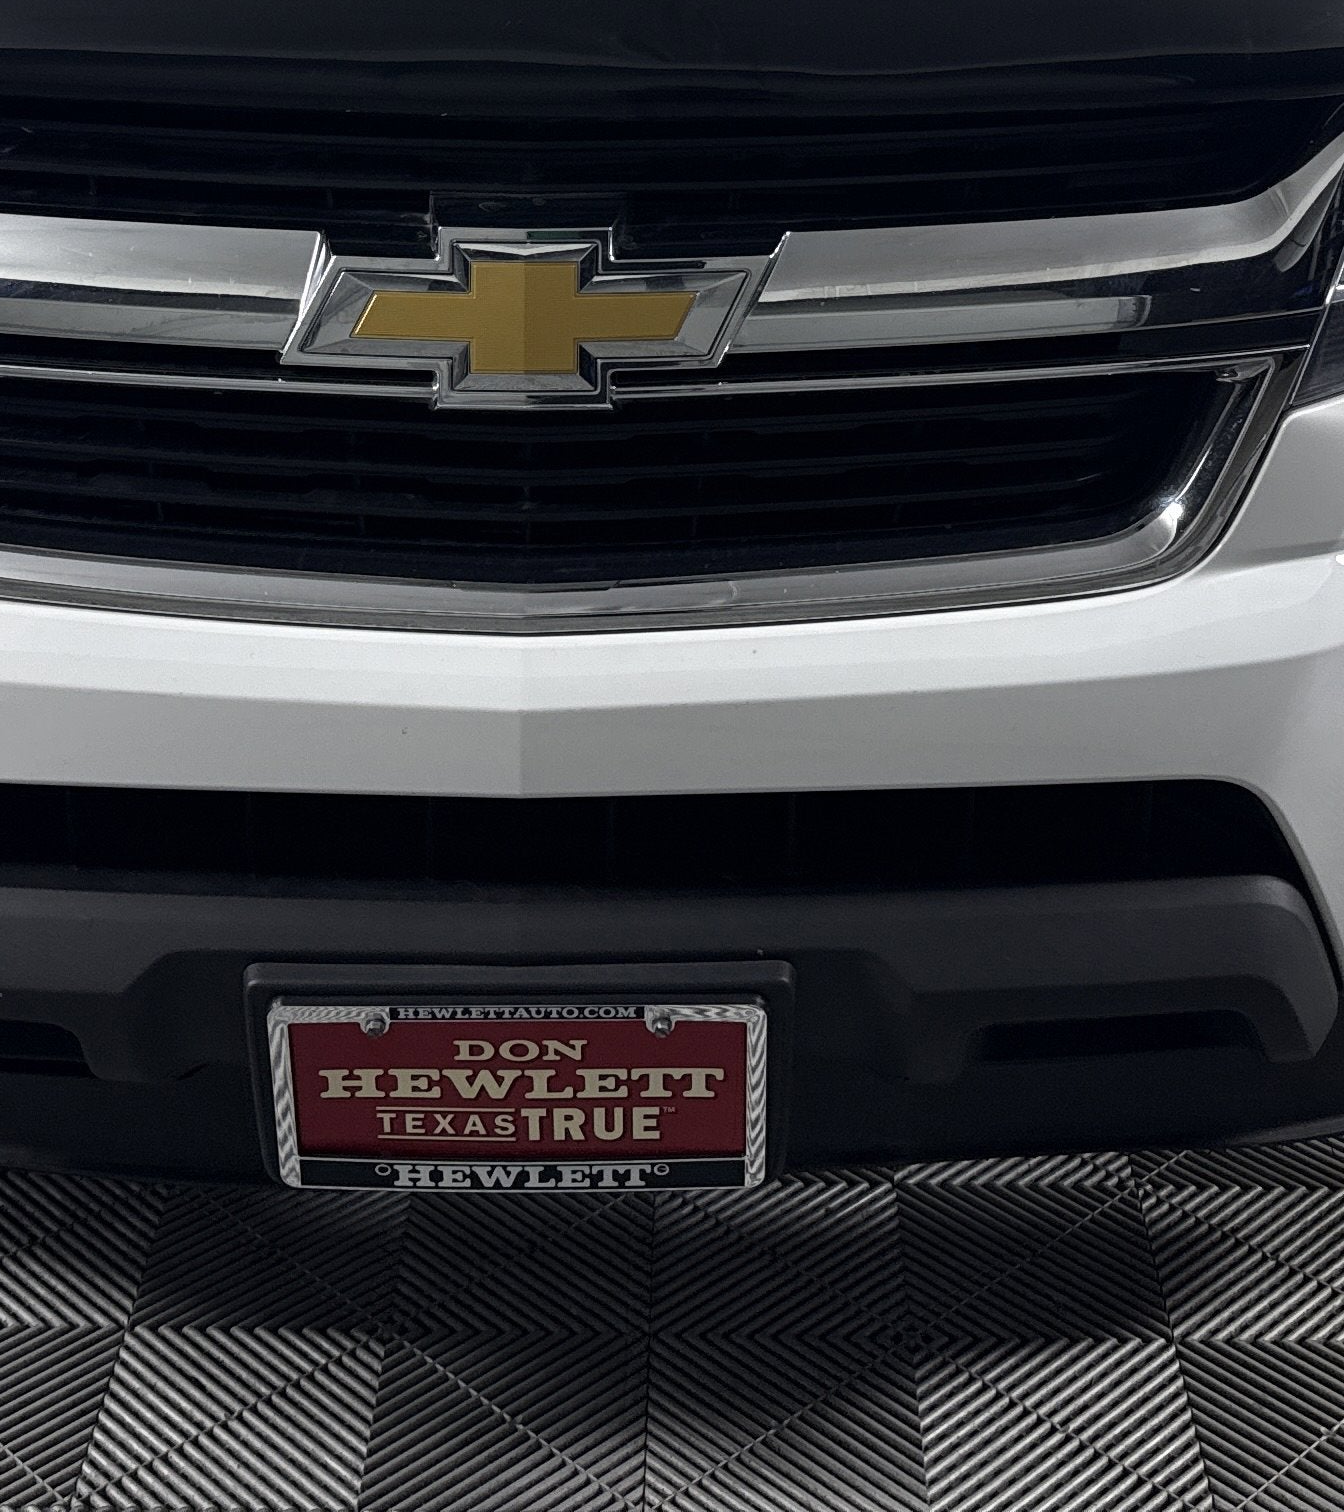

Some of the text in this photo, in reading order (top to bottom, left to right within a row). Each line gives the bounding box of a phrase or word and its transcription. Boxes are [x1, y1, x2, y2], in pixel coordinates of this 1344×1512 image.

[397, 1006, 637, 1020] HEWLETTAUTO.COM
[453, 1039, 588, 1062] DON
[318, 1067, 725, 1100] HEWLETT
[393, 1164, 652, 1188] HEWLETT
